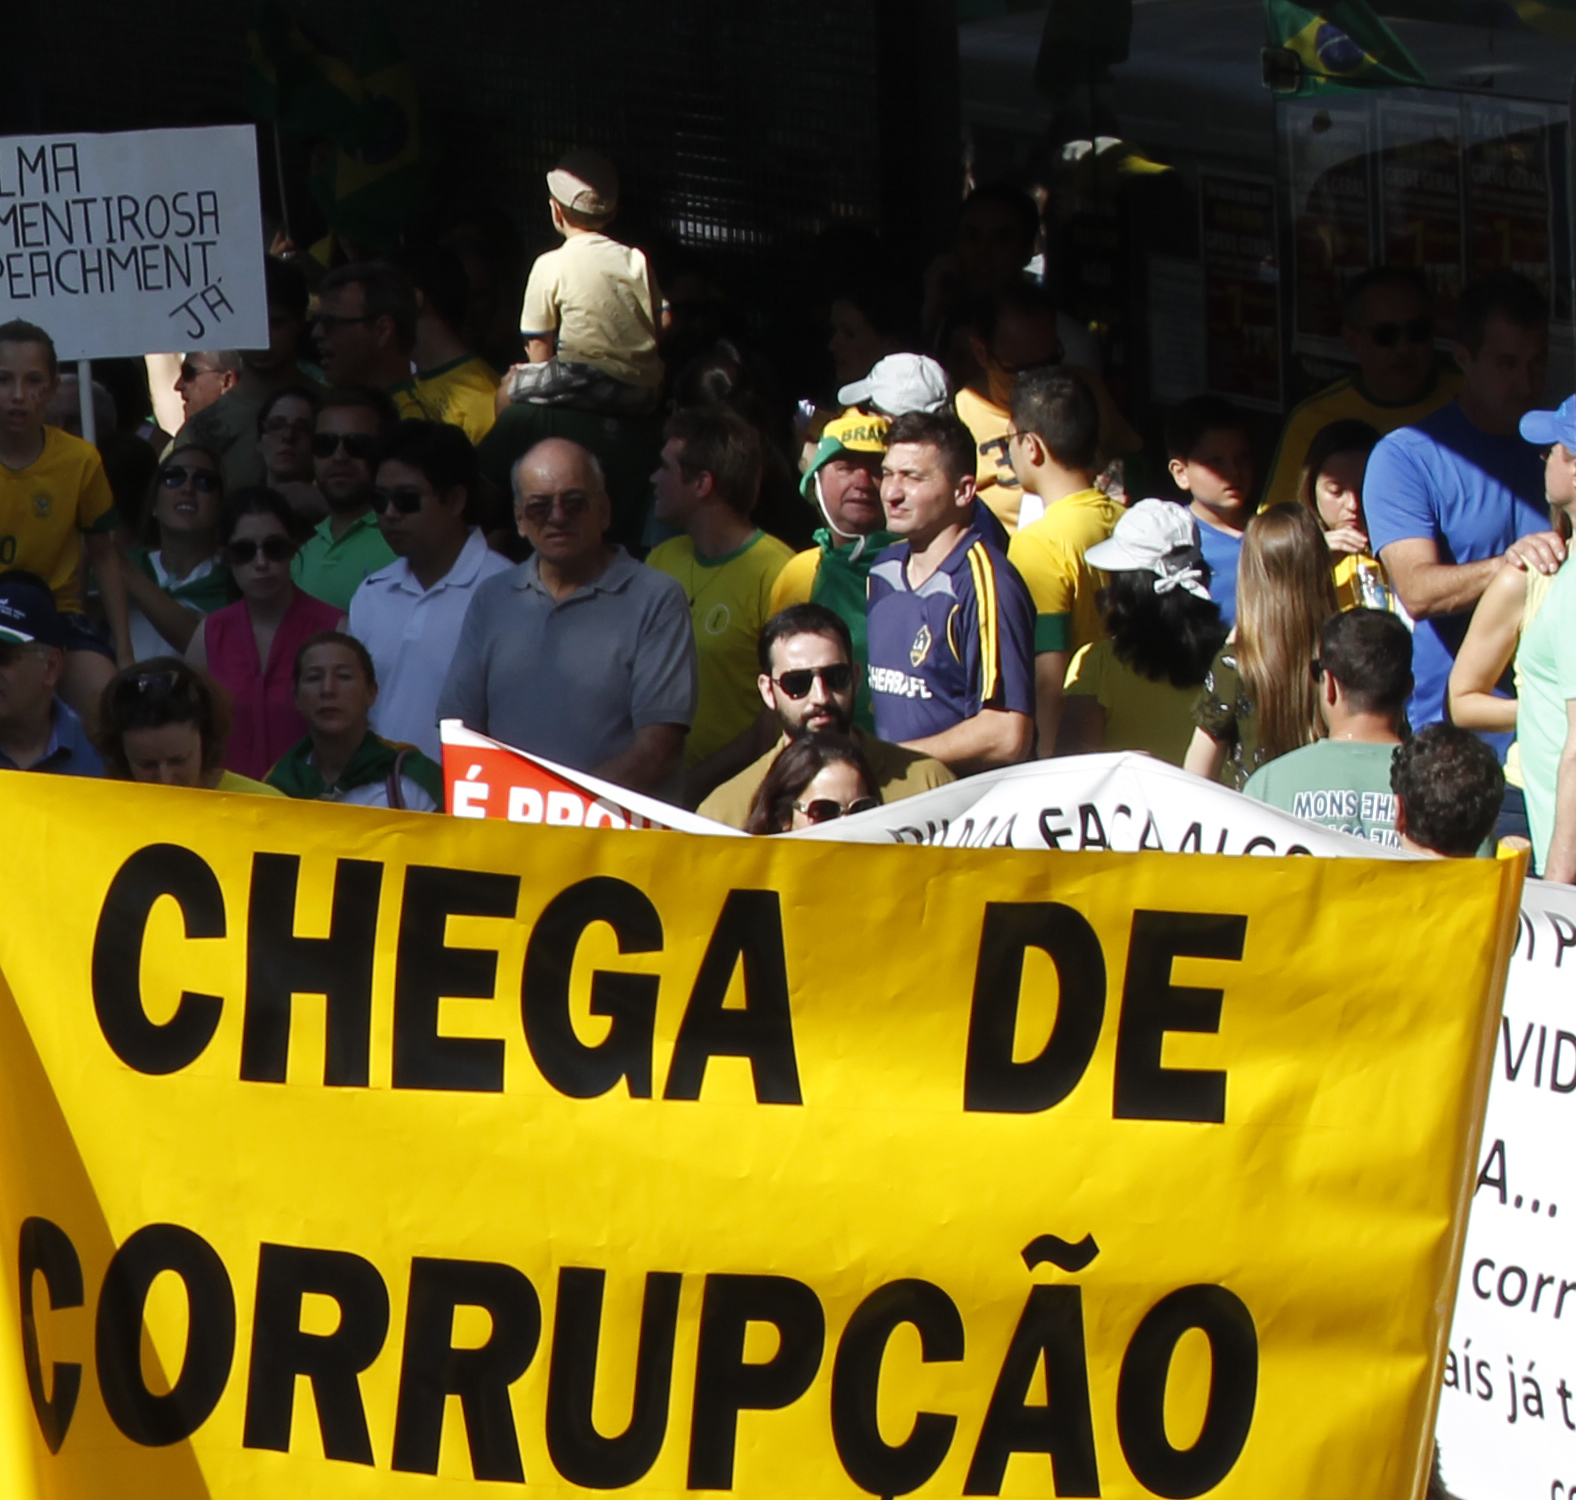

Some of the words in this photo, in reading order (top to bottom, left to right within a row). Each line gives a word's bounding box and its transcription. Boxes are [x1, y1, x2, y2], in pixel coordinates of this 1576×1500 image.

[452, 764, 487, 819] É
[91, 841, 803, 1106] CHEGA
[963, 900, 1248, 1125] DE
[1505, 1353, 1545, 1425] já
